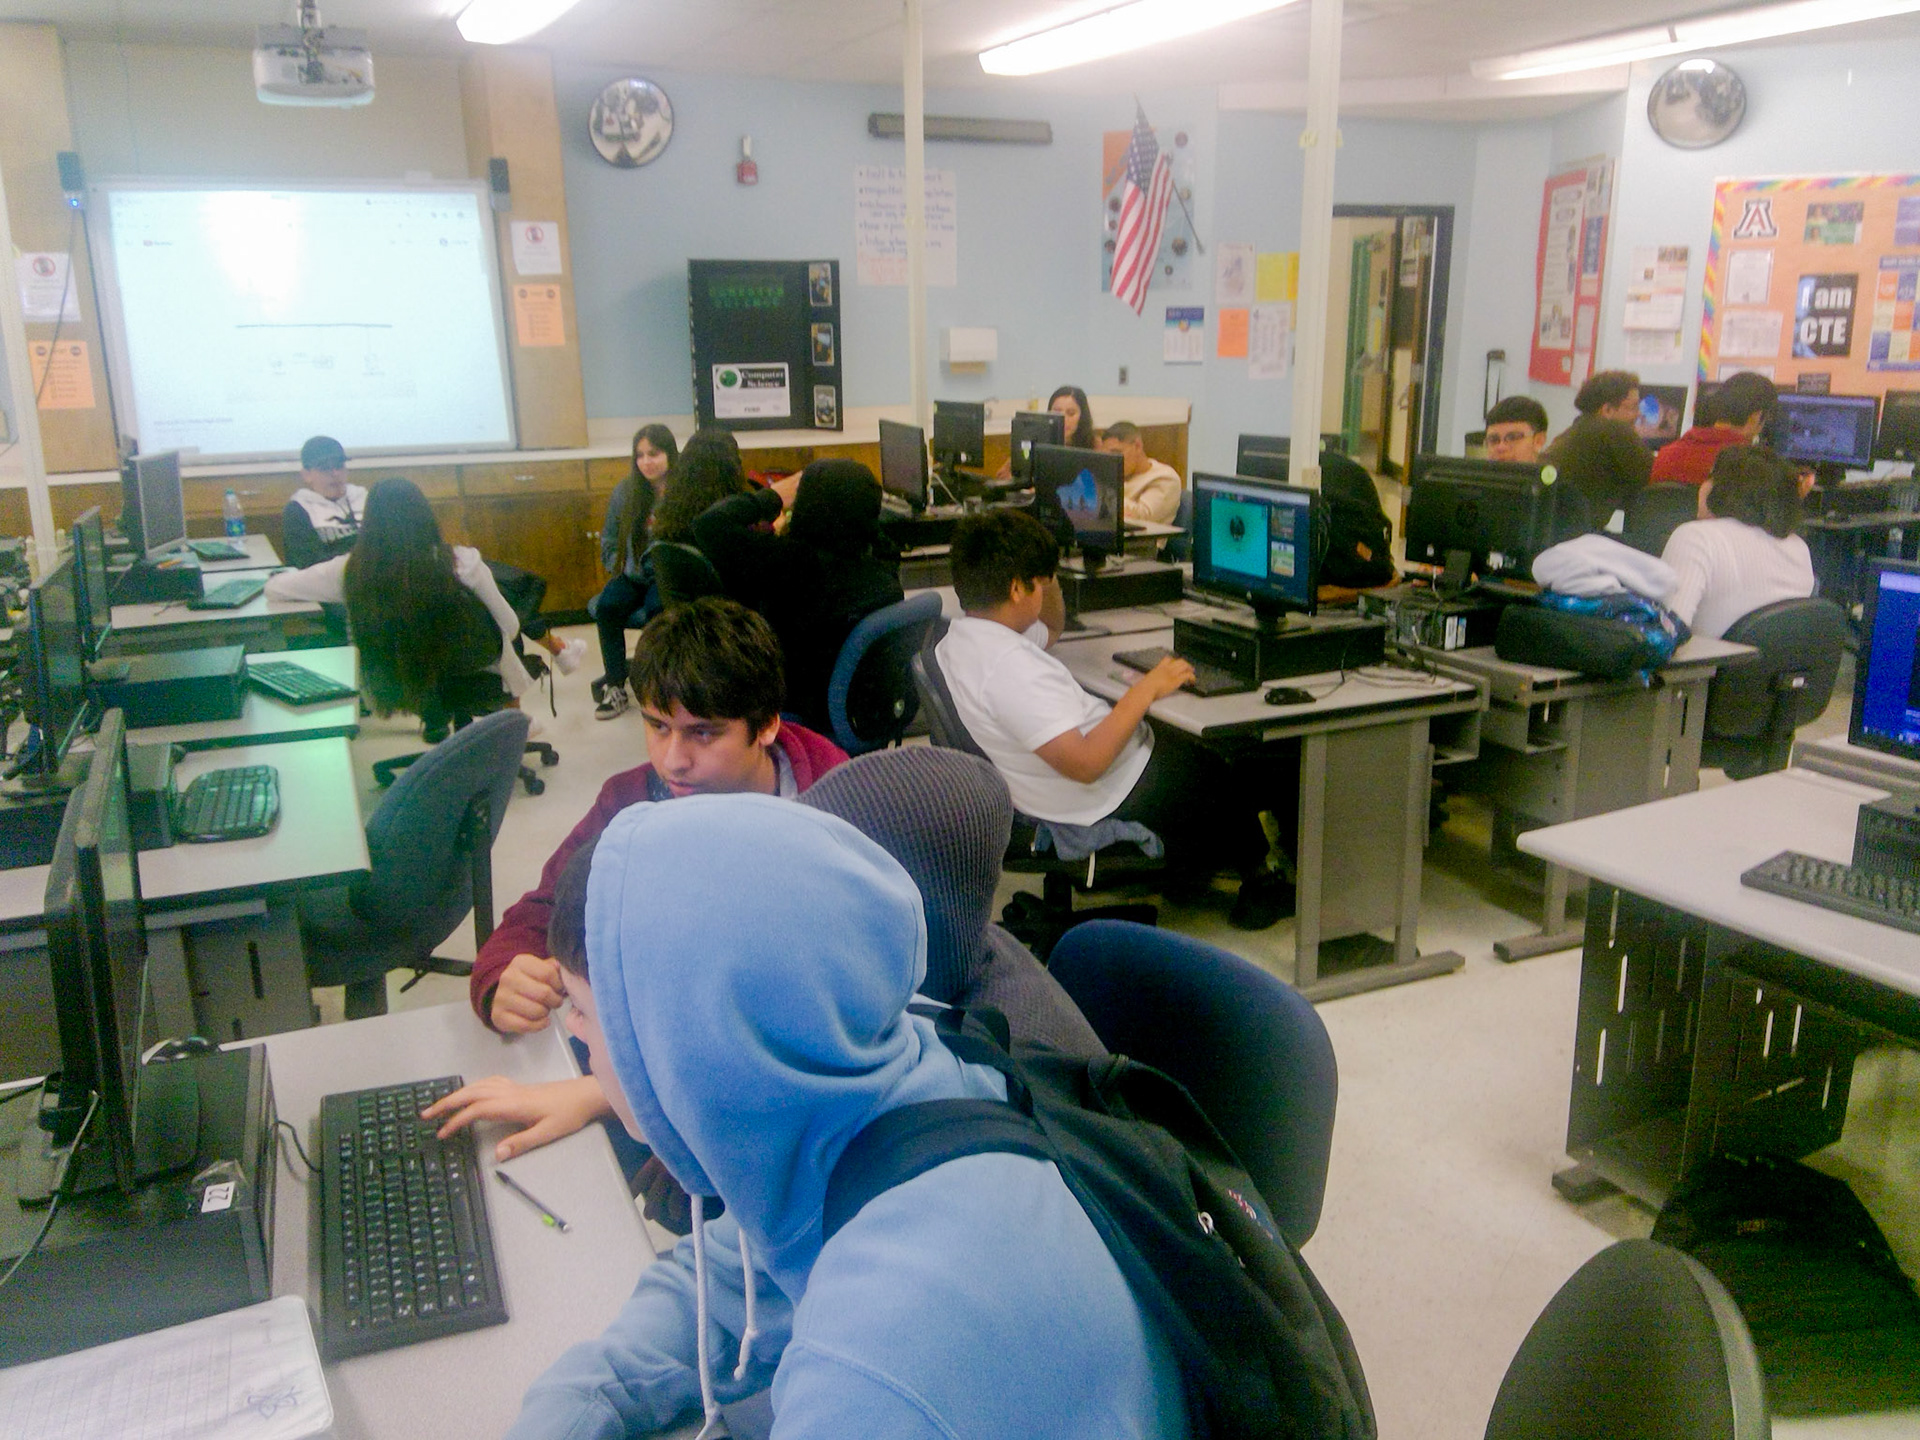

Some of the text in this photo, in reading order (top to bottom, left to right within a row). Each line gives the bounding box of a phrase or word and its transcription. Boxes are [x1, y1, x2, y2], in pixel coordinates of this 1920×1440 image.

[1814, 286, 1852, 310] am
[1800, 315, 1847, 345] CTE
[742, 370, 784, 380] Computer
